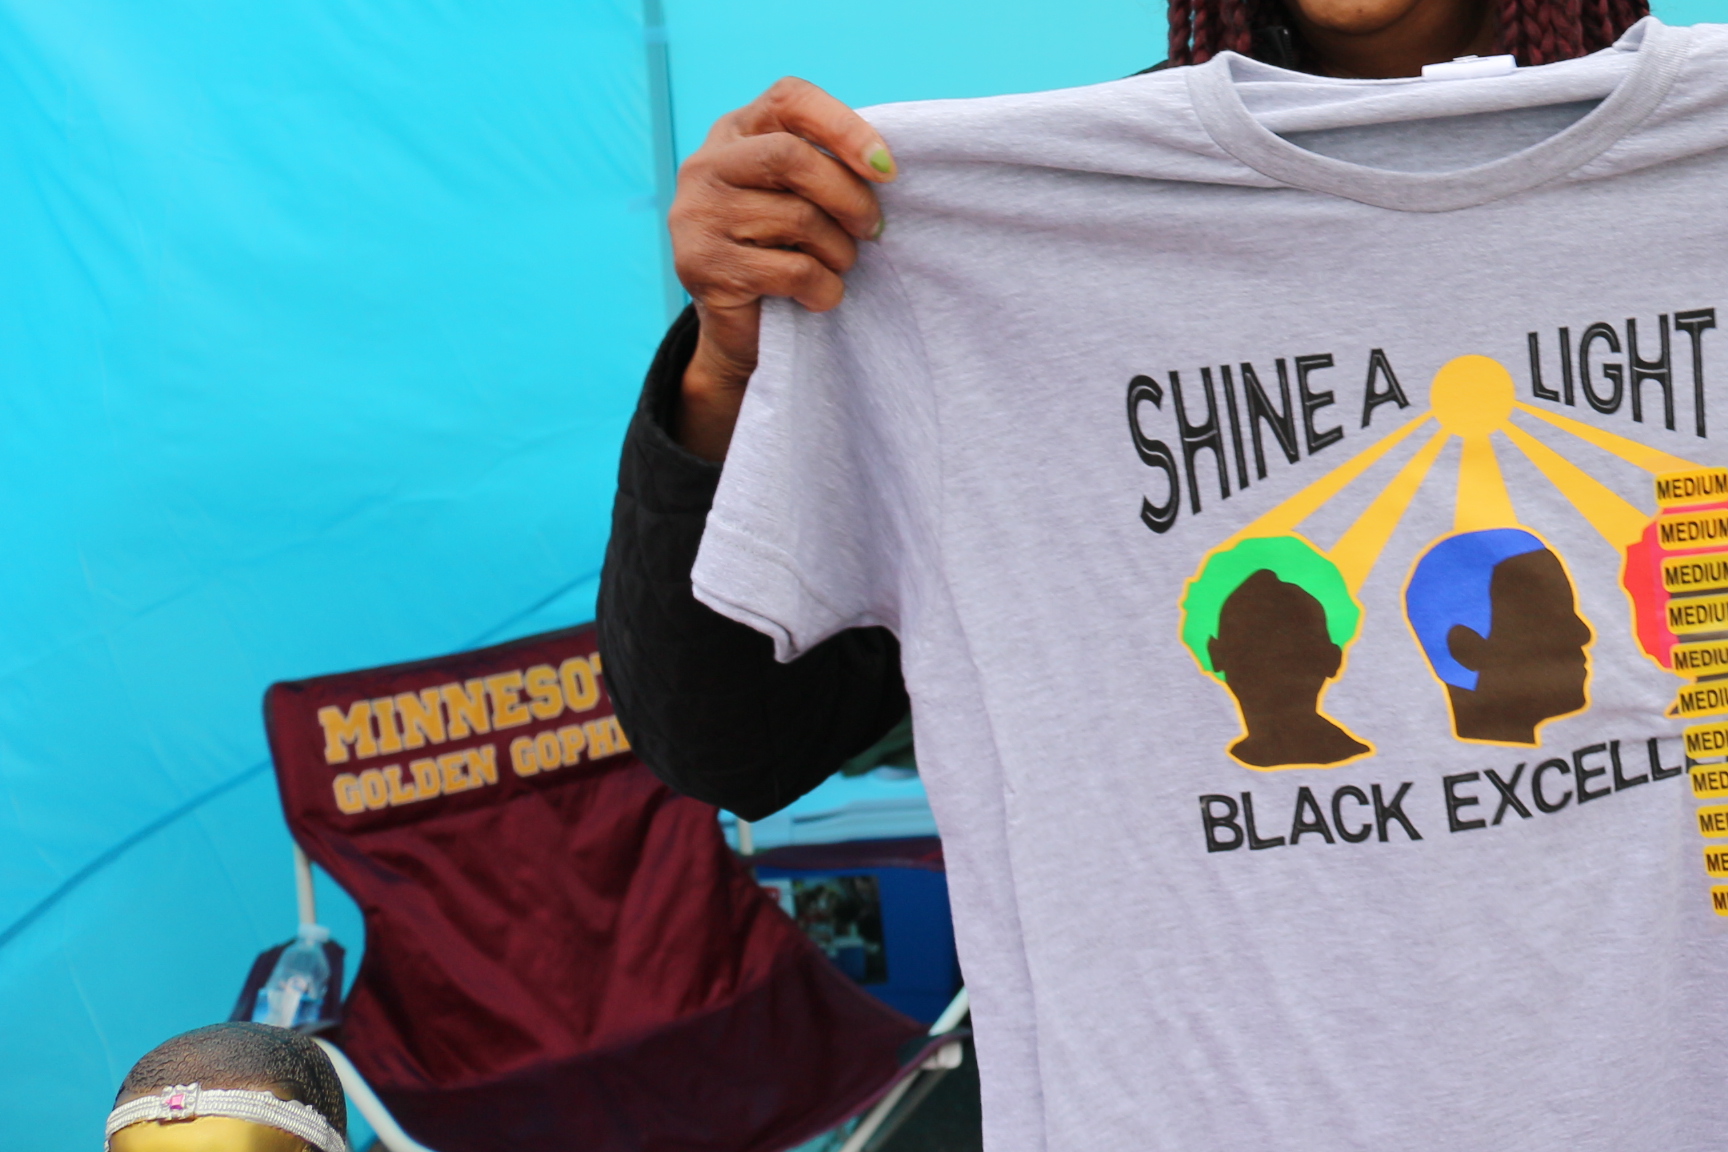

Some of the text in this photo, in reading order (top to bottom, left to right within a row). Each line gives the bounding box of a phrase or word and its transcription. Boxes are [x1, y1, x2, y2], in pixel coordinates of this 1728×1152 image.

[1126, 353, 1344, 534] SHINE
[1361, 348, 1411, 429] A
[1528, 307, 1717, 439] LIGHT
[318, 651, 602, 765] MINNESO
[332, 744, 499, 815] GOLDEN
[1199, 781, 1423, 853] BLACK
